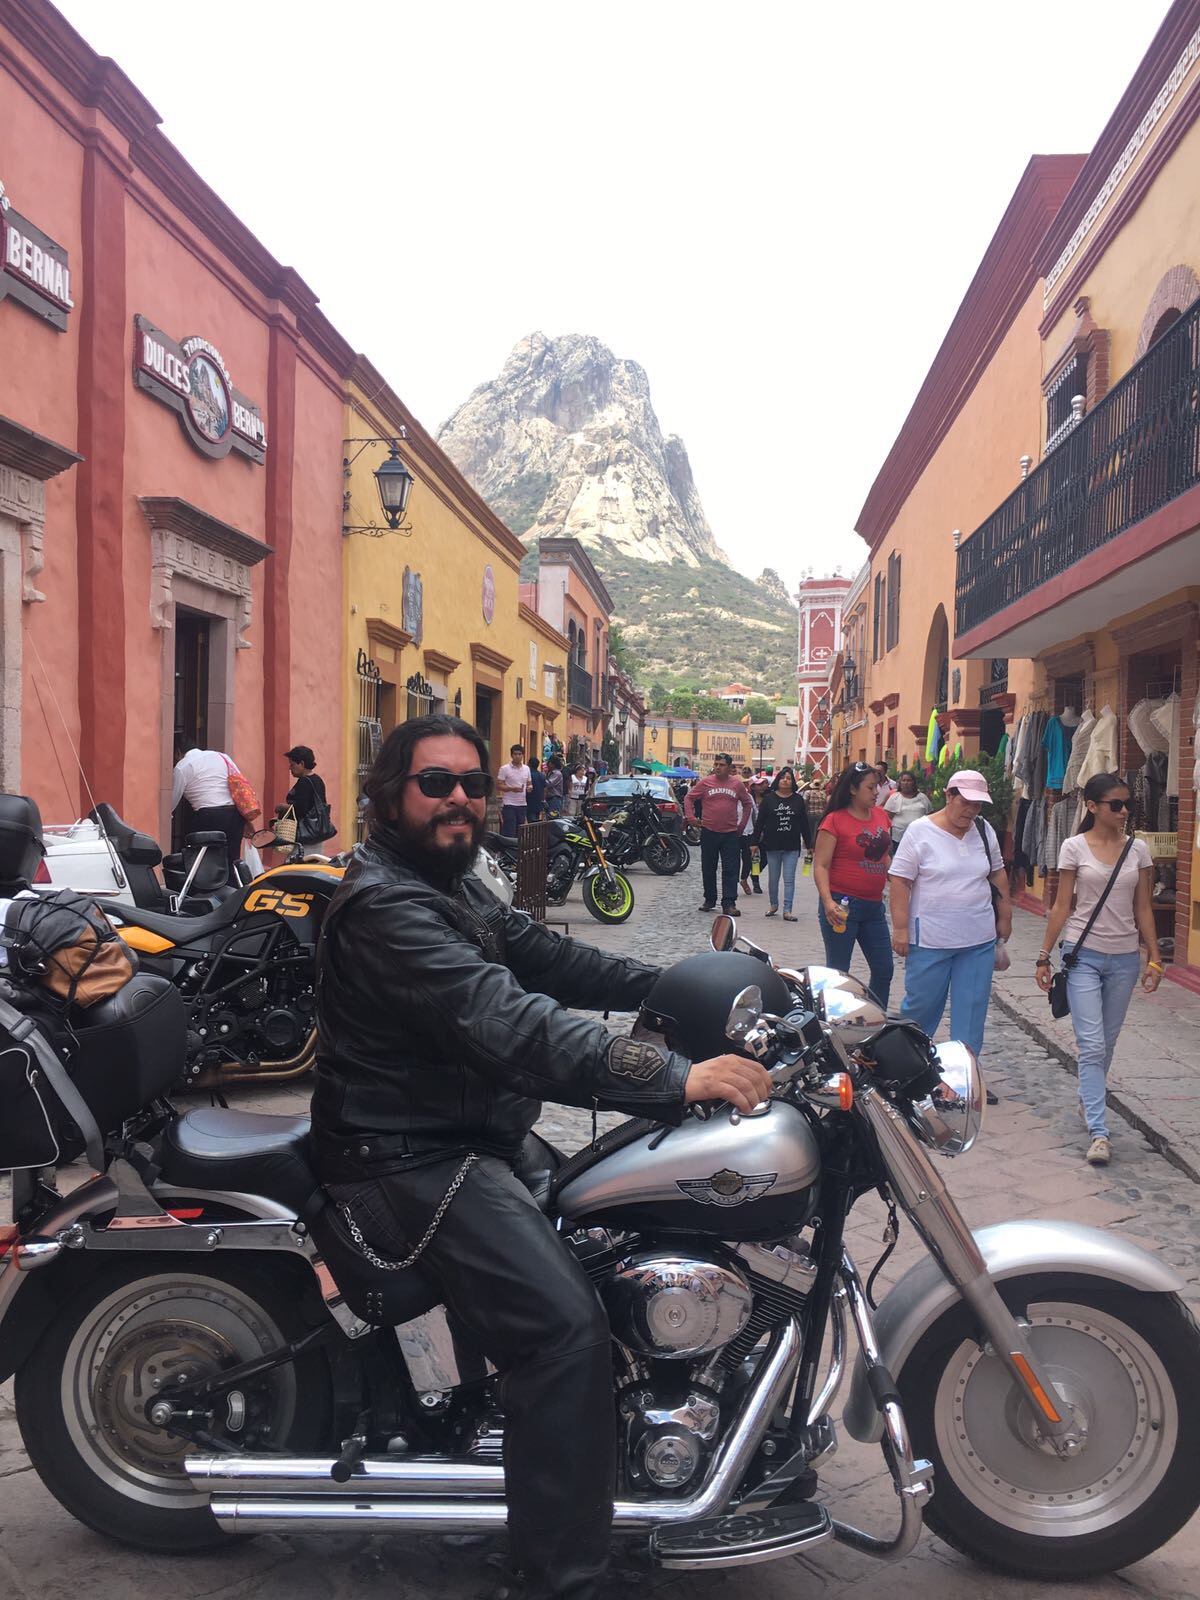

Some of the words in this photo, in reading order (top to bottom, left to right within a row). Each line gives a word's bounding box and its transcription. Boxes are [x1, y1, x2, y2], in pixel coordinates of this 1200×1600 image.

[8, 226, 74, 308] BERNAL
[143, 335, 191, 394] DULCES
[232, 401, 268, 447] BERNAL
[244, 889, 314, 917] GS
